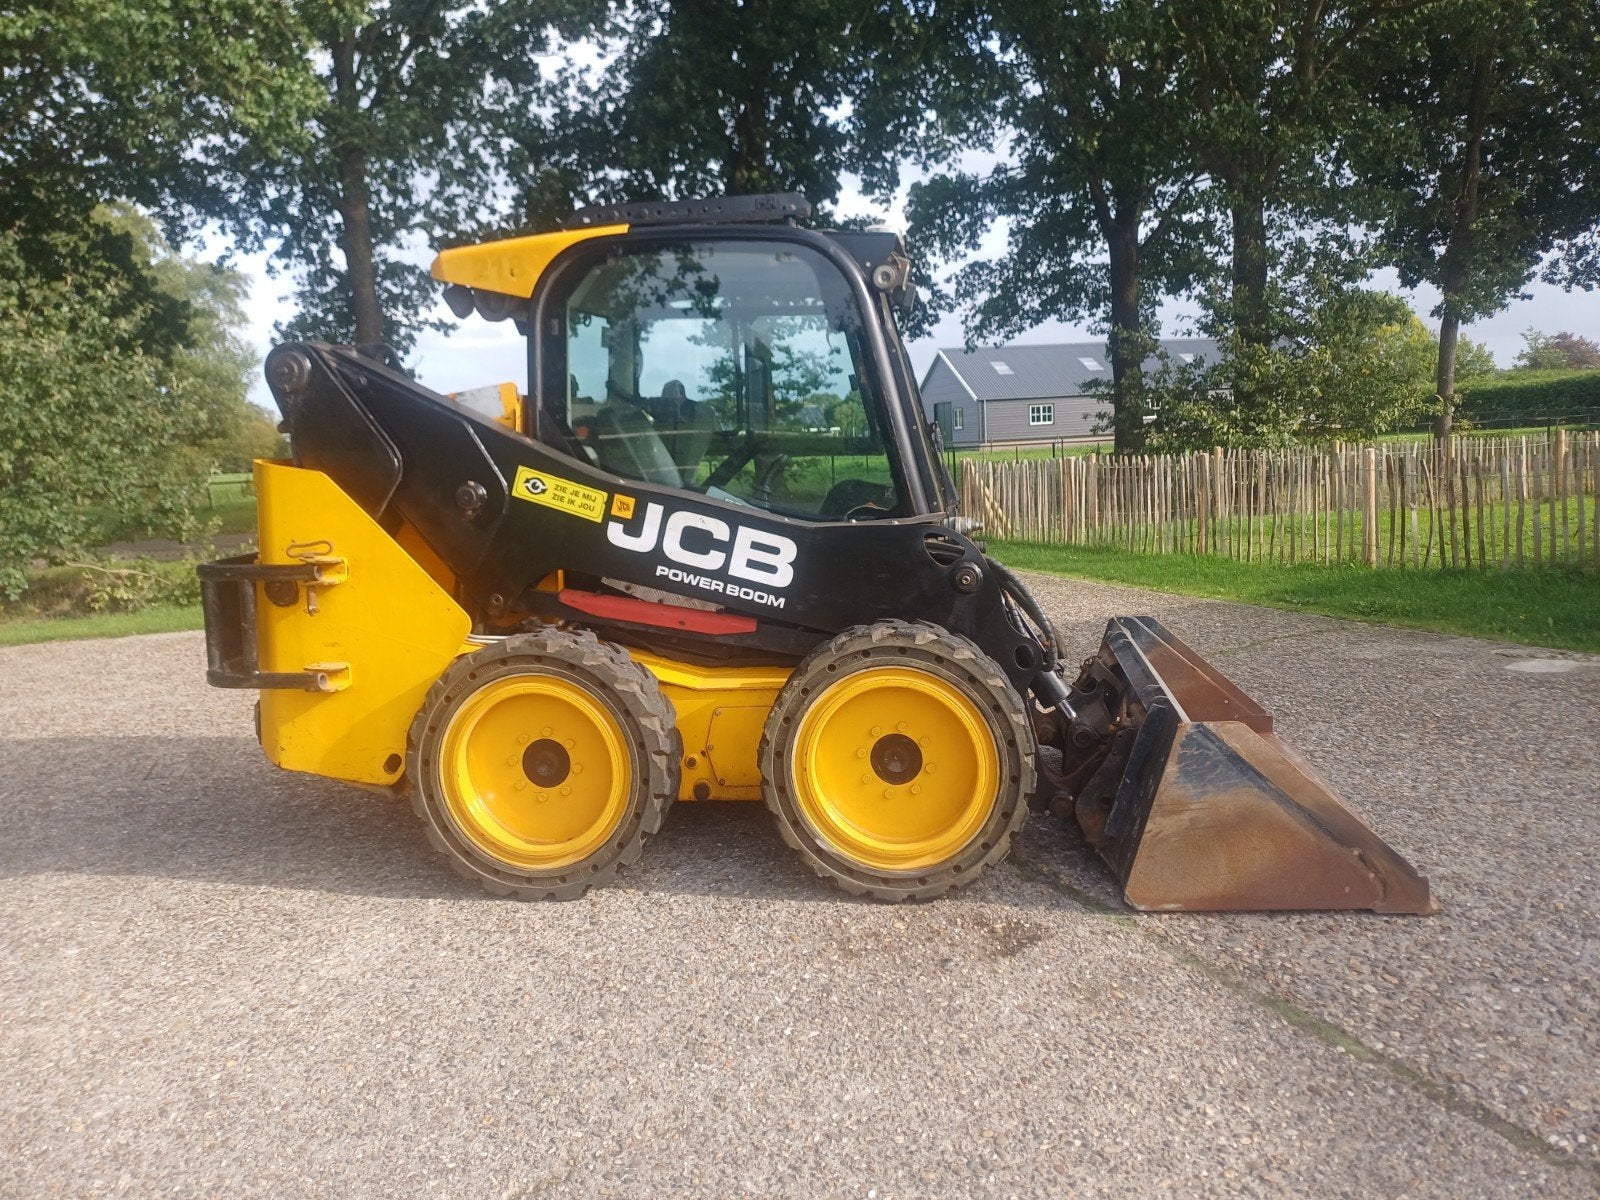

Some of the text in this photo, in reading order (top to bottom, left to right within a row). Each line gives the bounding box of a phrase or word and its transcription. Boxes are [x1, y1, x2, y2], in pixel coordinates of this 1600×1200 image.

[552, 493, 595, 512] ZIE IK JOU
[554, 484, 597, 503] ZIE JE MIJ
[607, 502, 797, 588] JCB
[655, 565, 785, 609] POWER BOOM
